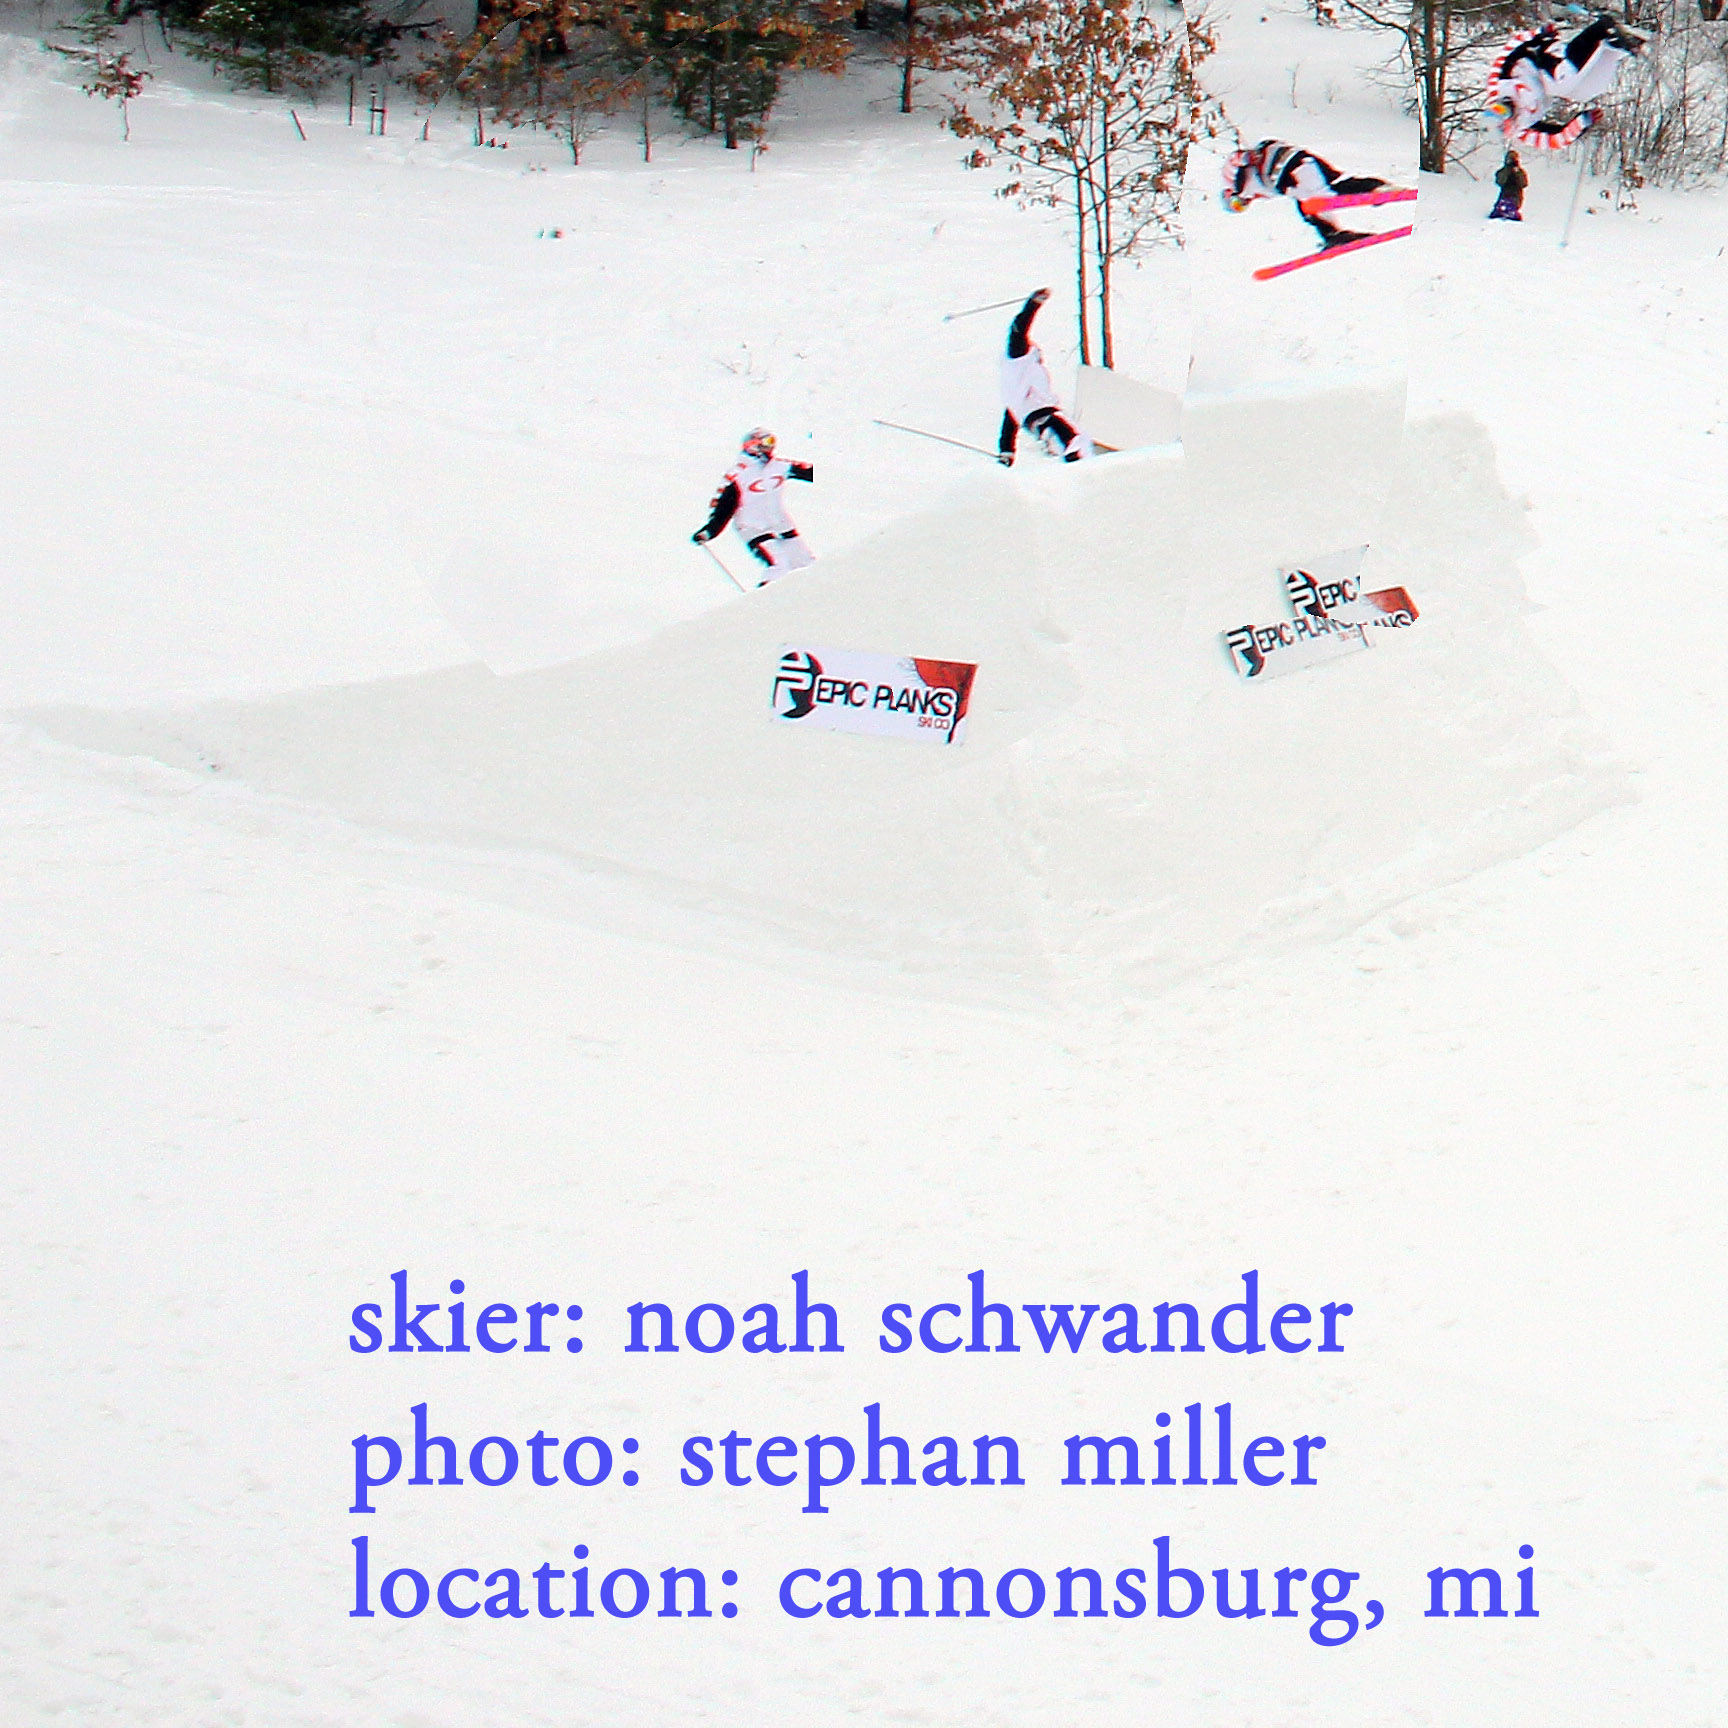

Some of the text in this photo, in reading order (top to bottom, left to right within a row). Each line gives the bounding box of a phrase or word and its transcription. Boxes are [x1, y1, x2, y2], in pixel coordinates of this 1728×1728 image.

[1318, 578, 1358, 610] EPIC
[1256, 622, 1295, 654] EPIC
[816, 677, 957, 717] EPIC PLANKS
